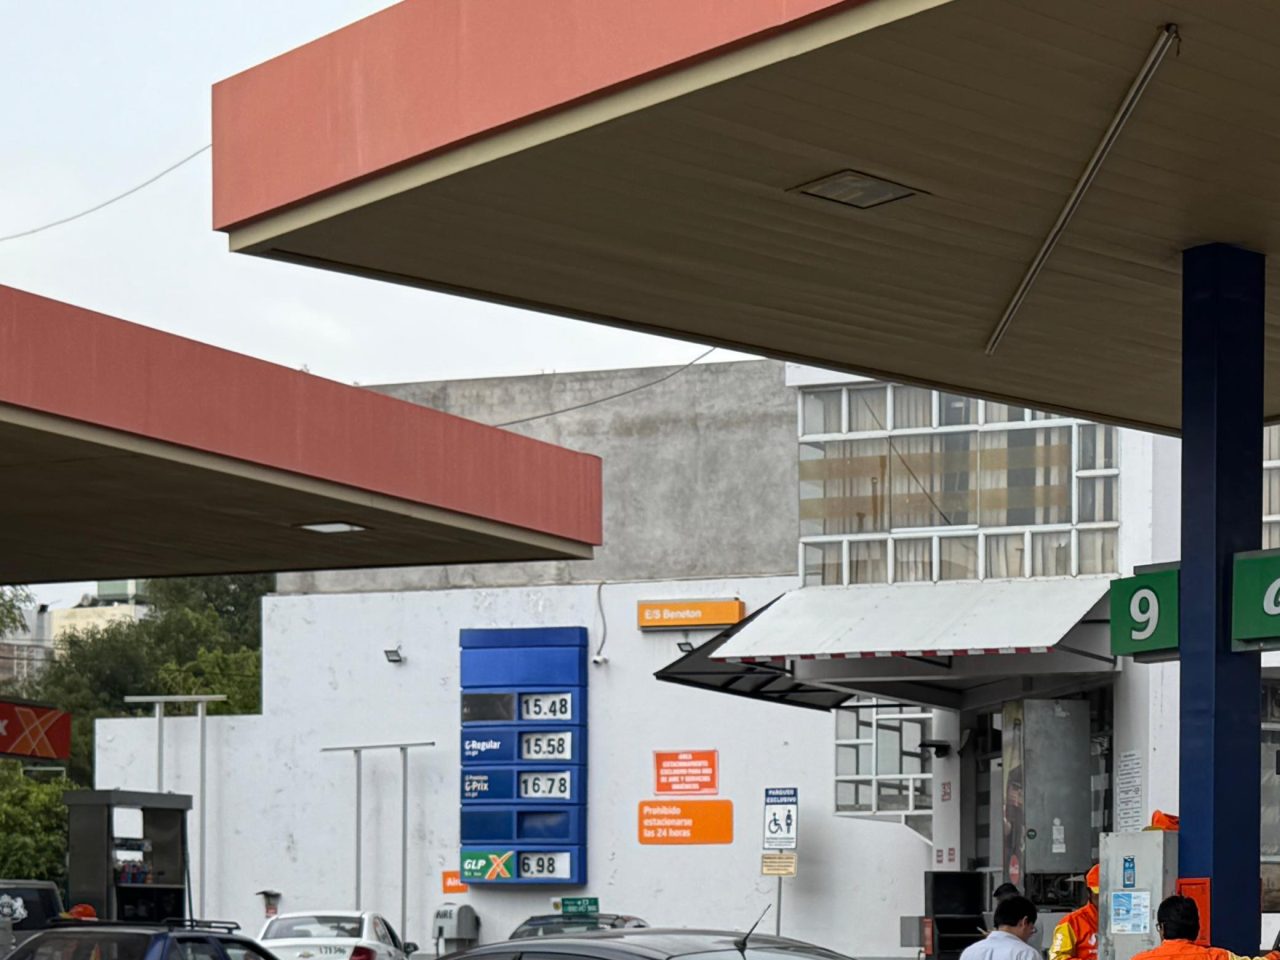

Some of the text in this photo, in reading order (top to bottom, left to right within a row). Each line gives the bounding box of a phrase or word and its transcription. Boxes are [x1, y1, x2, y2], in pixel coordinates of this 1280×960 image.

[1130, 588, 1159, 640] 9
[523, 698, 568, 716] 15.48
[524, 738, 565, 755] 15.58
[523, 777, 567, 795] 16.78
[643, 805, 681, 815] Prohibido
[643, 818, 693, 827] estacionarse
[643, 828, 691, 837] las 24 horas
[463, 859, 486, 870] GLP
[522, 857, 556, 875] 6.98
[436, 909, 453, 919] AIRE
